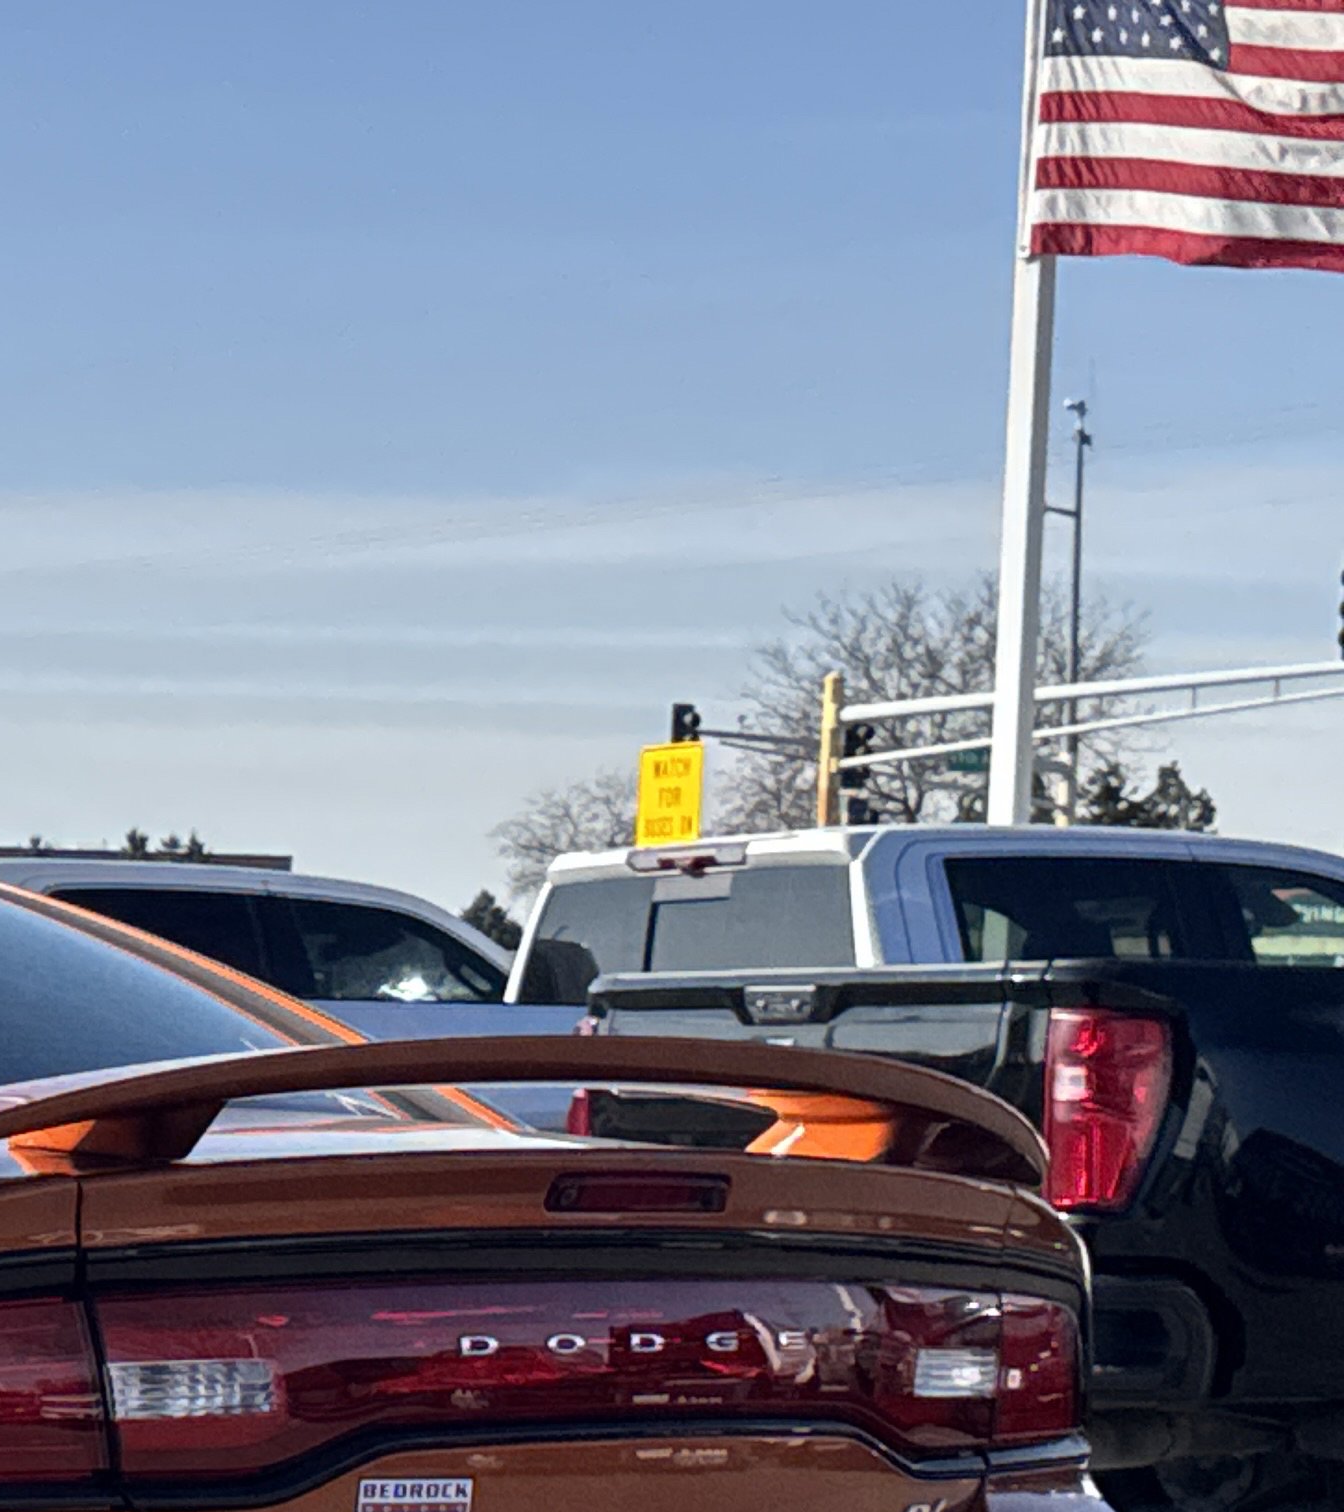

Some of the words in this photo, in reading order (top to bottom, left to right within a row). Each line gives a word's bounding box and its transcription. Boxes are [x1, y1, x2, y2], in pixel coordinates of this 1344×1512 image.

[658, 785, 682, 808] FOR
[460, 1331, 807, 1356] DODGE
[363, 1483, 468, 1498] BEDROCK
